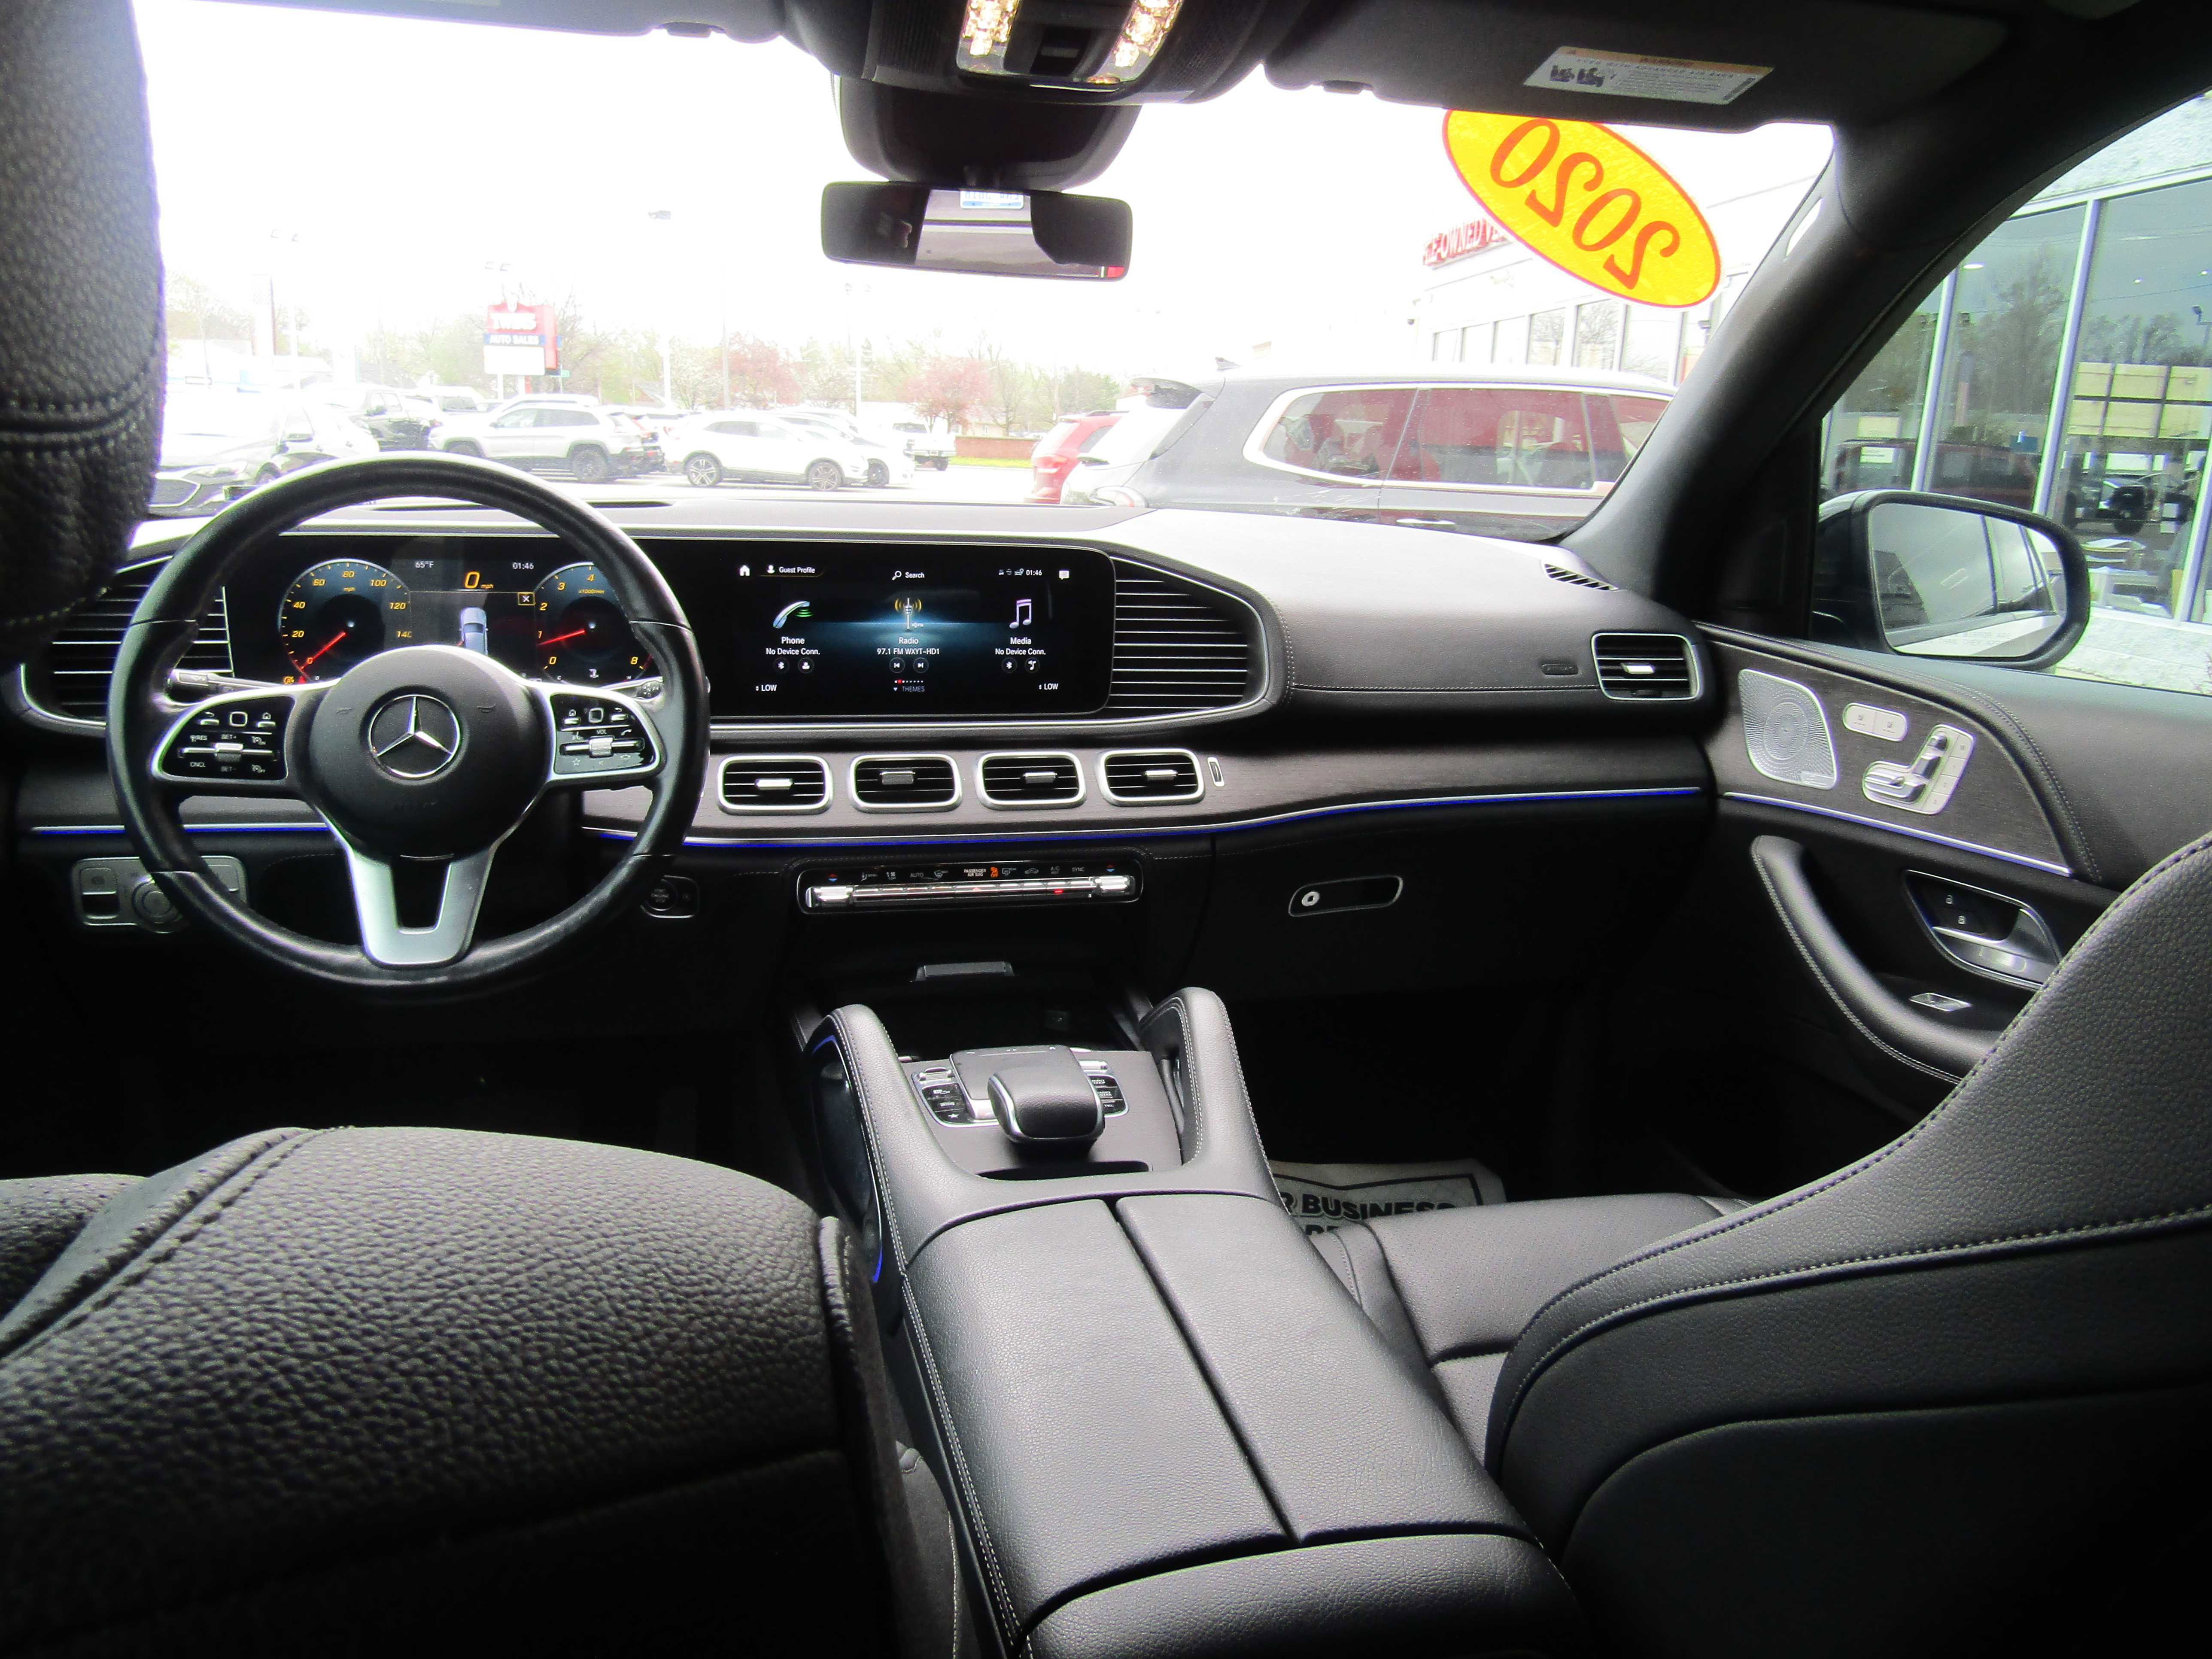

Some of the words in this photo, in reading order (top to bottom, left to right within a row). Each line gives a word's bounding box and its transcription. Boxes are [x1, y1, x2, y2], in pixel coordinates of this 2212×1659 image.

[489, 334, 511, 344] AUTO
[513, 335, 539, 345] SALES
[464, 571, 480, 589] 0
[587, 574, 595, 582] 4
[558, 582, 565, 590] 3
[389, 602, 406, 610] 120
[540, 602, 548, 611] 2
[781, 636, 805, 644] Phone
[549, 656, 557, 665] 0
[630, 656, 638, 665] 8
[1302, 1194, 1456, 1219] BUSINE
